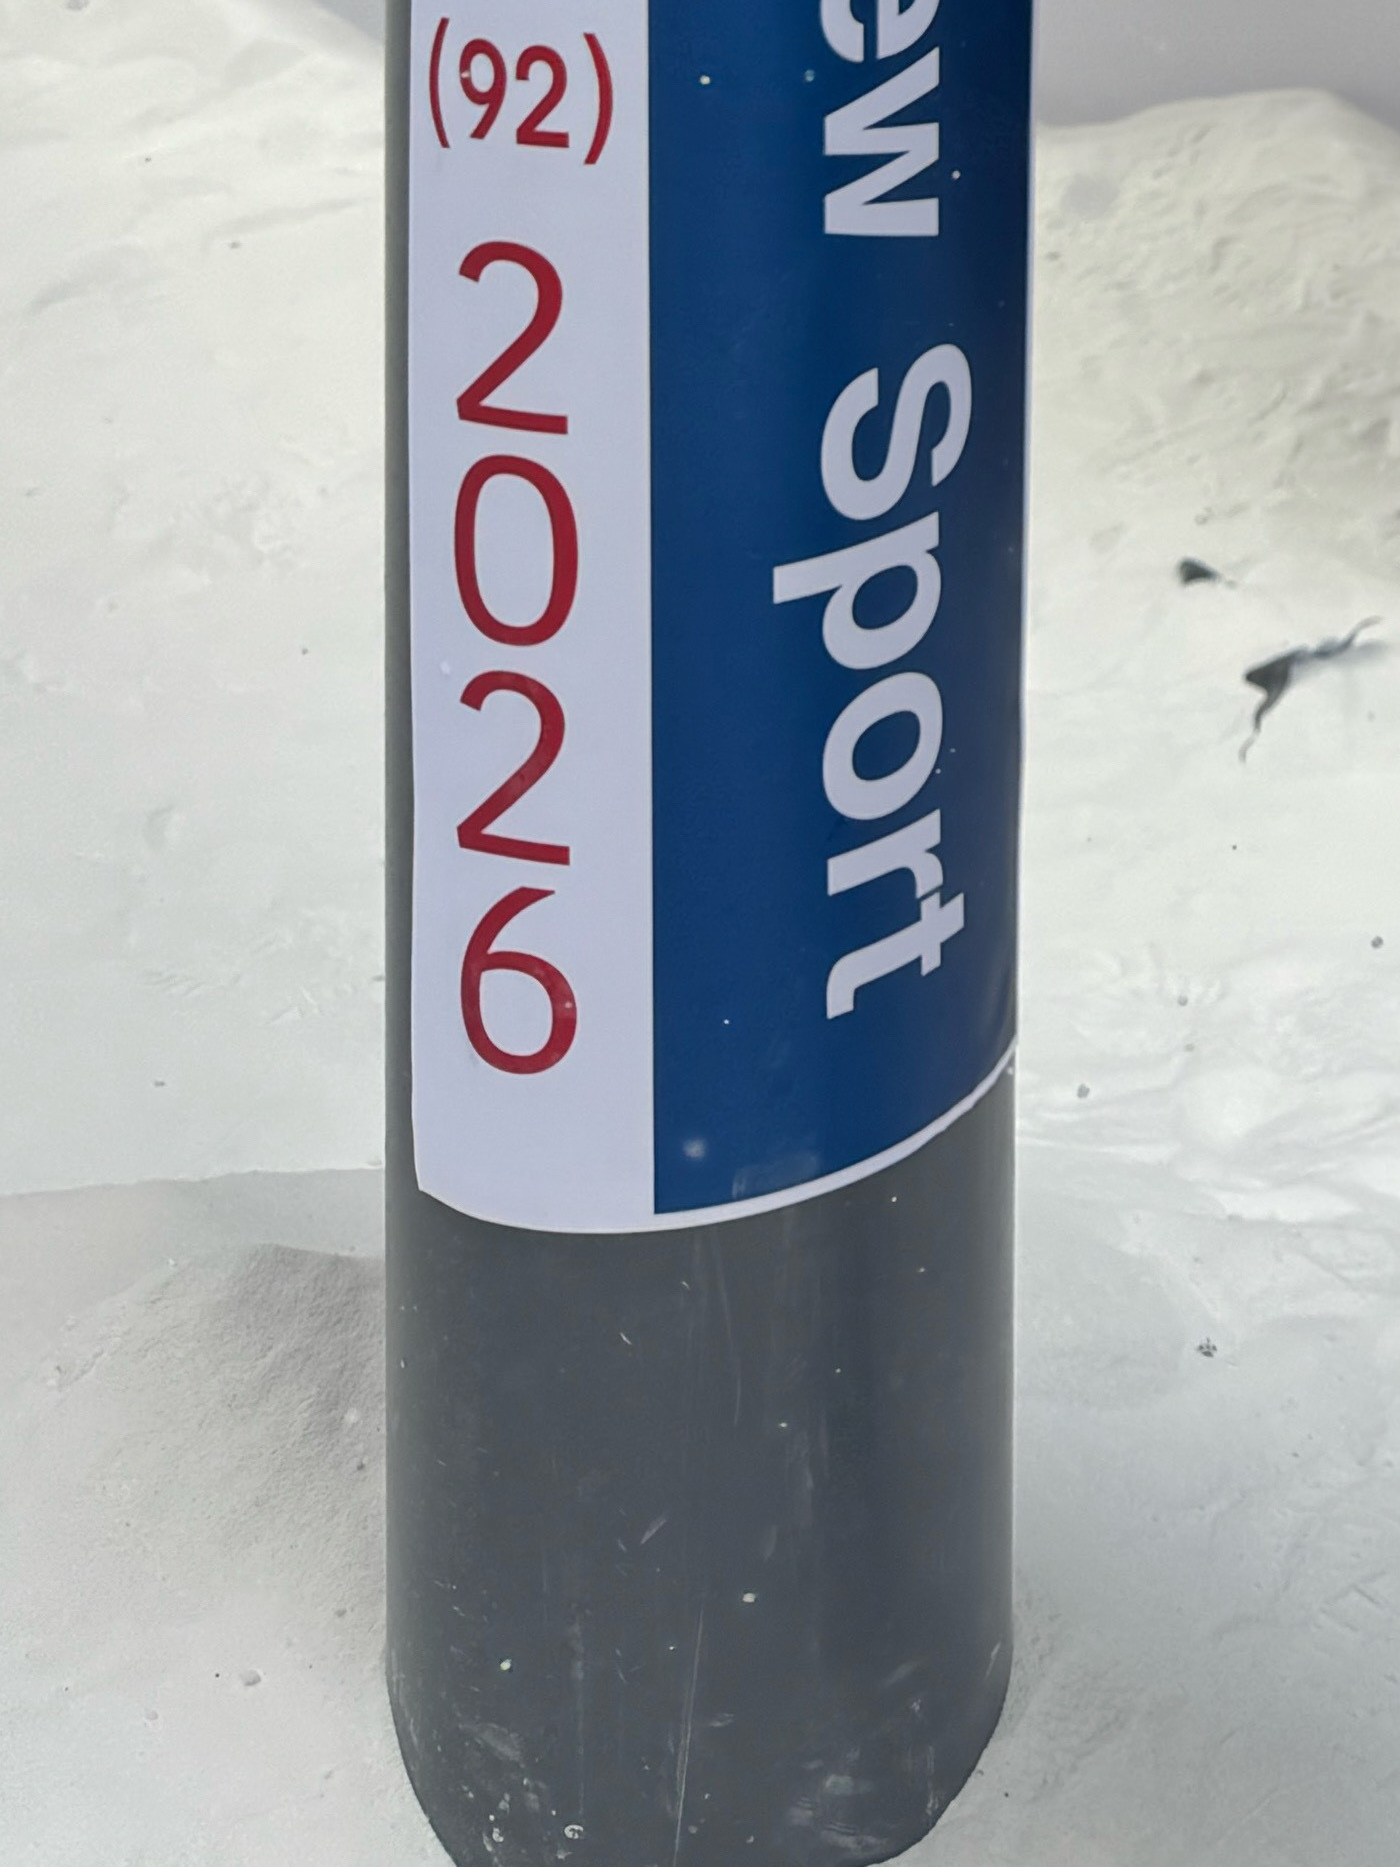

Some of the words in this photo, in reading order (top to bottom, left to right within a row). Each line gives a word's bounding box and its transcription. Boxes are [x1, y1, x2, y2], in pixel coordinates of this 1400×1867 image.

[429, 18, 613, 165] (92)
[453, 239, 579, 1076] 2026
[773, 342, 972, 1020] Sport
